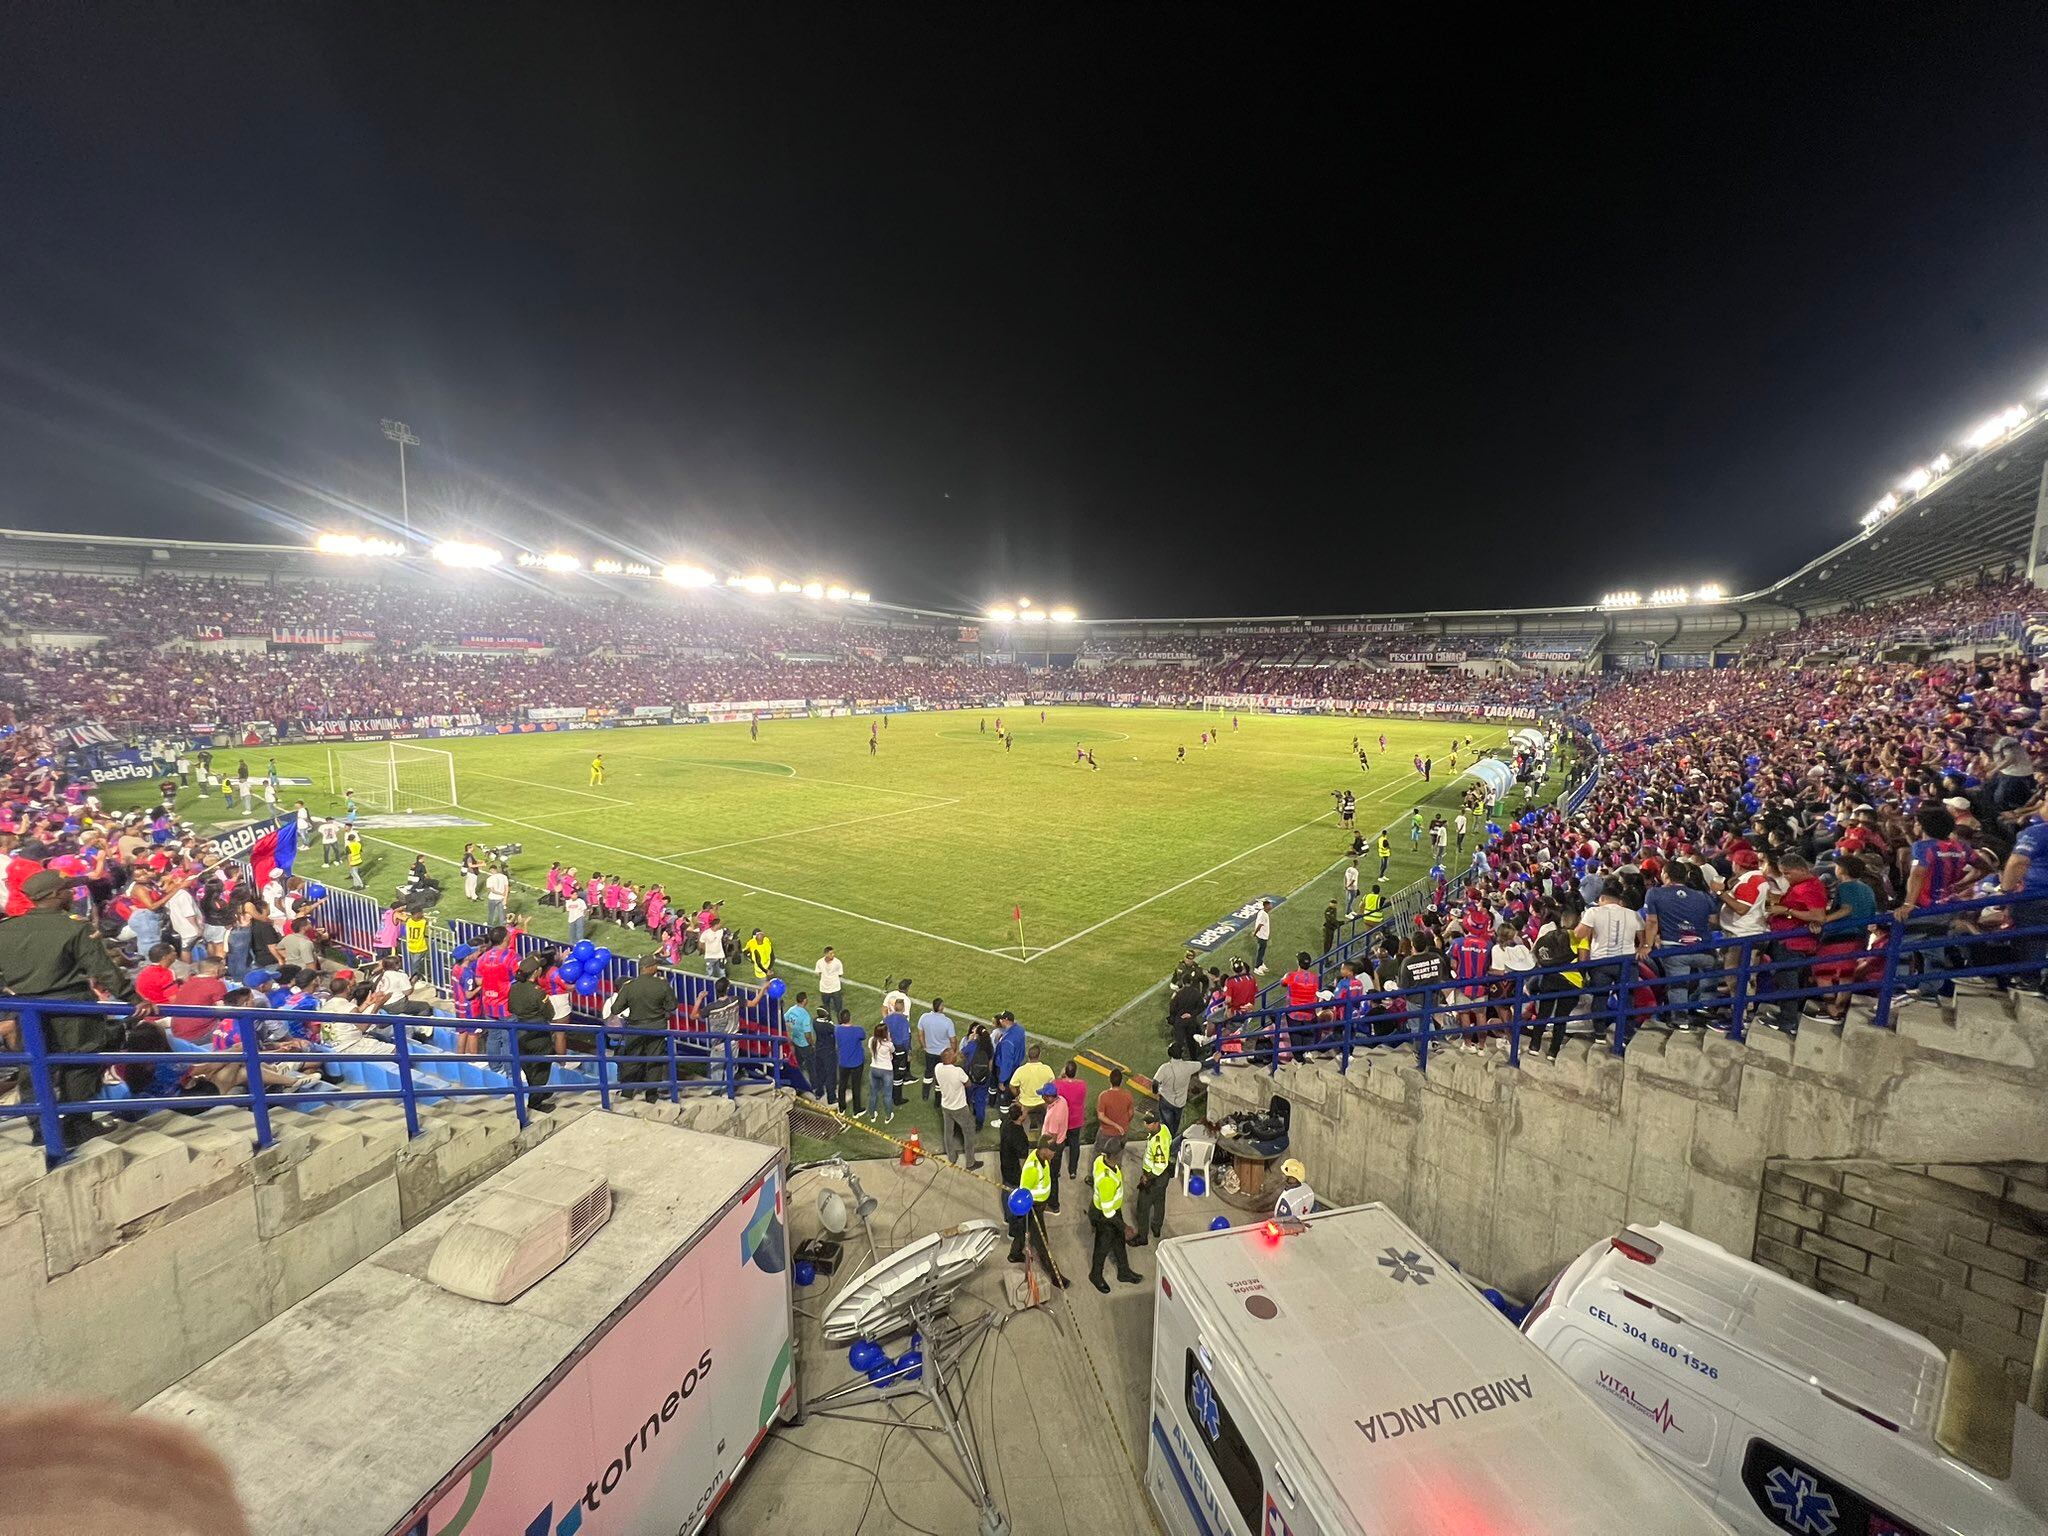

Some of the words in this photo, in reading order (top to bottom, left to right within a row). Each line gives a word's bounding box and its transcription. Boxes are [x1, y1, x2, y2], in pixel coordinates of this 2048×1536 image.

[272, 627, 291, 643] LA
[294, 628, 342, 644] KALLE
[1226, 626, 1276, 634] MAGDALENA
[1521, 651, 1571, 661] ALMENDRO
[1483, 705, 1536, 719] TAGANGA
[91, 763, 153, 783] BetPlay
[409, 927, 421, 940] 10
[1589, 1306, 1618, 1328] CEL.
[1622, 1322, 1647, 1343] 304
[1651, 1337, 1678, 1358] 680
[1682, 1354, 1719, 1380] 1526
[1600, 1370, 1637, 1402] VITAL
[1354, 1373, 1533, 1444] AMBULANCIA
[582, 1348, 713, 1511] torneos
